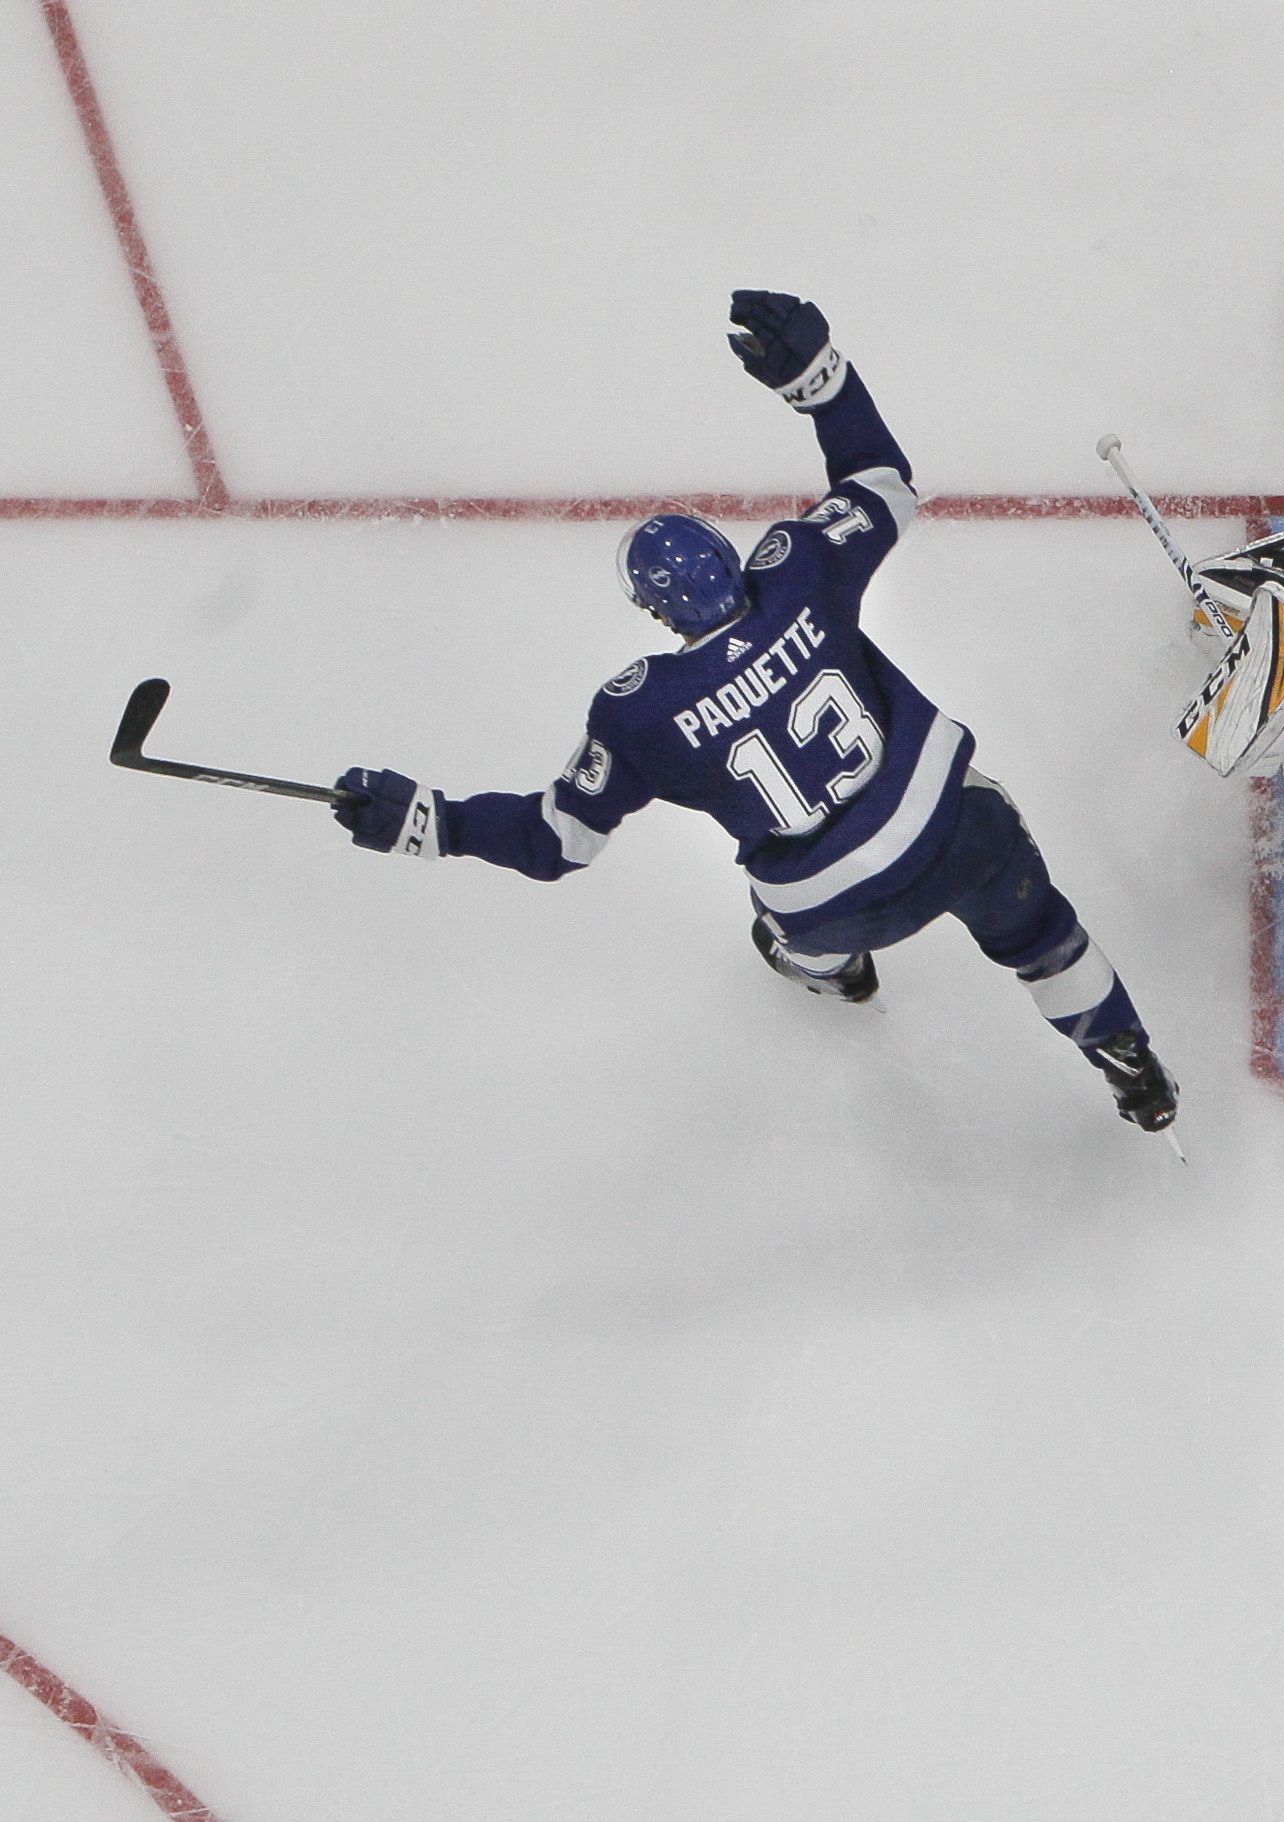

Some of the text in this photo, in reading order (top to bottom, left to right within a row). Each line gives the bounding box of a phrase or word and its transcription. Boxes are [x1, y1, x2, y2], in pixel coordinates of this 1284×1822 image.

[799, 496, 875, 546] 13
[1204, 601, 1234, 639] PRO
[674, 607, 825, 748] PAQUETTE
[1176, 633, 1251, 739] CCM
[726, 669, 887, 837] 13
